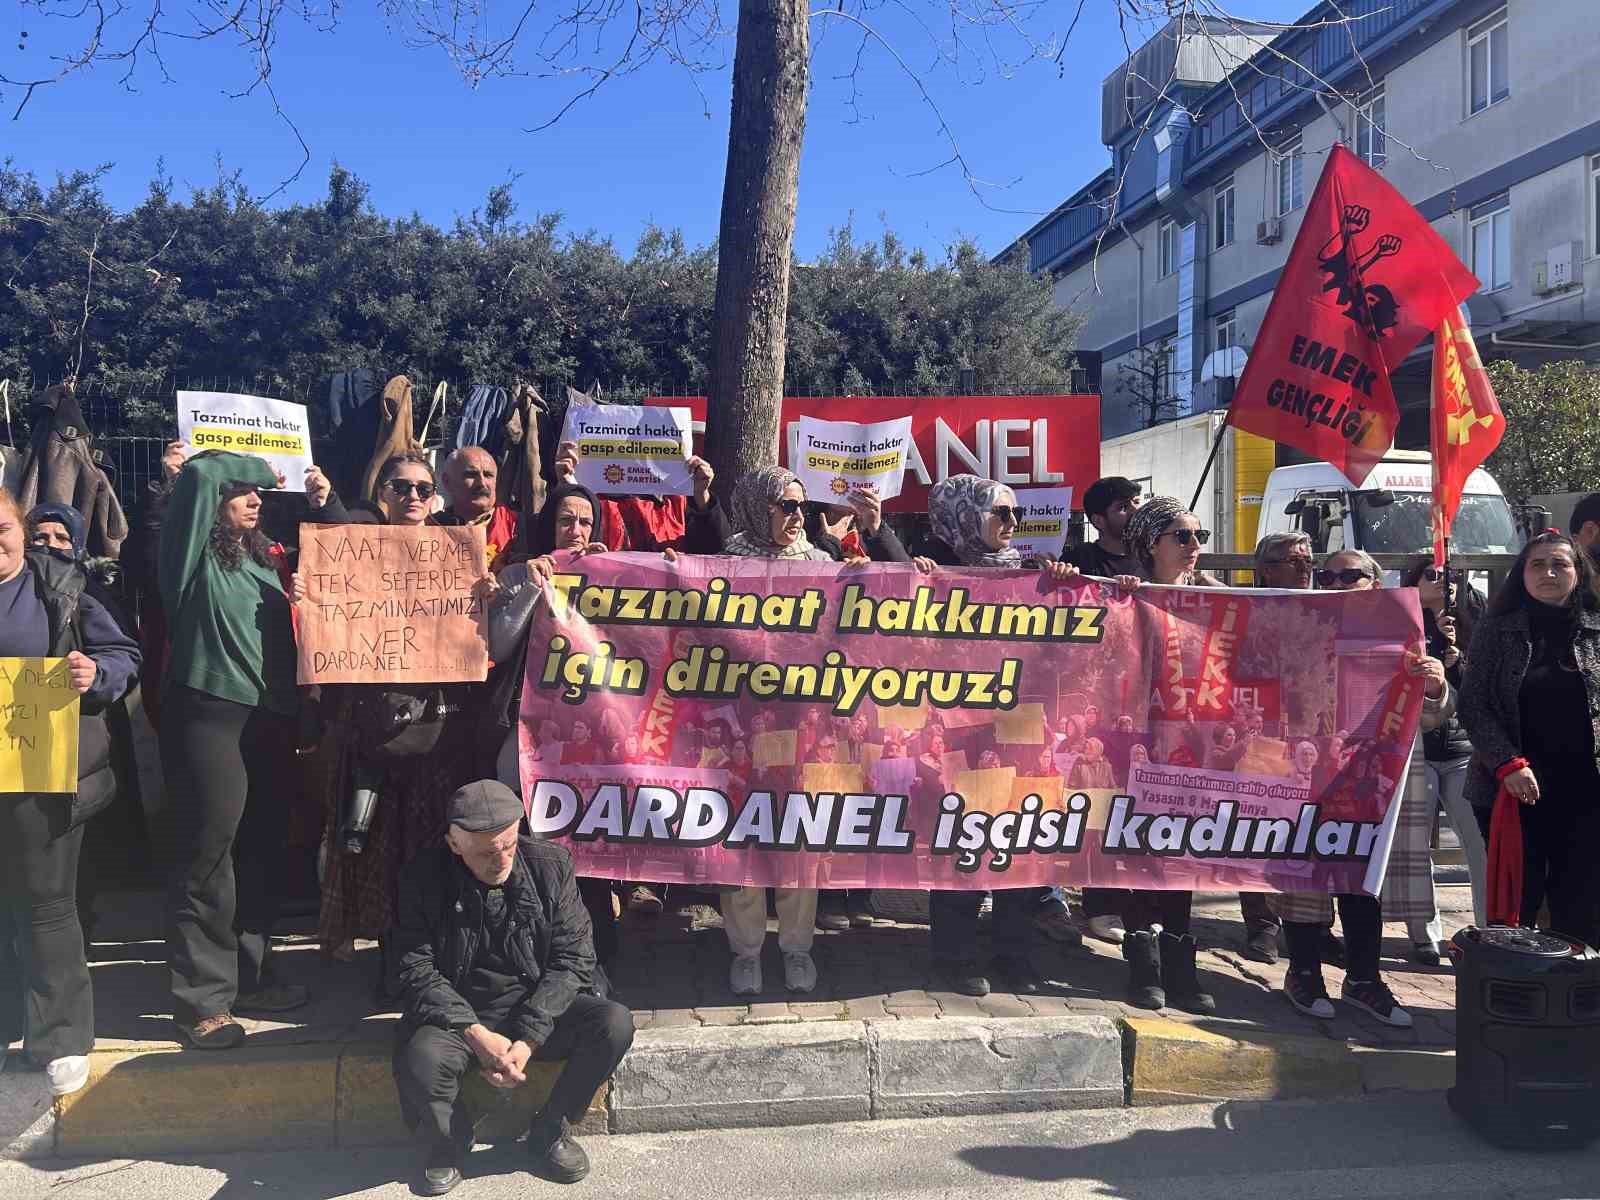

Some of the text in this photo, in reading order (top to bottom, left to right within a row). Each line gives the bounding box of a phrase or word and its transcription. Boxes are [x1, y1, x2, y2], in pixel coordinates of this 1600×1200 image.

[1288, 334, 1377, 398] EMEK
[191, 410, 261, 427] Tazminat
[1267, 378, 1377, 446] GENÇLİĞİ
[195, 433, 302, 450] gasp edilemez!
[579, 422, 641, 436] Tazminat
[581, 441, 682, 456] gasp edilemez!
[807, 435, 903, 453] Tazminat haktır
[808, 450, 900, 471] gasp edilemez!
[1385, 475, 1424, 487] ALLAH
[1030, 504, 1065, 516] haktır
[1012, 519, 1061, 533] dilemez!
[314, 537, 473, 564] VAAT VERME
[312, 568, 467, 595] TEK SEFERDE
[550, 577, 1103, 639] Tazminat hakkımız
[360, 626, 421, 656] VER
[541, 637, 1019, 711] için direniyoruz!
[1135, 769, 1180, 786] Tazminat
[1182, 775, 1234, 792] hakkımıza
[1237, 782, 1267, 797] sahip
[1141, 790, 1185, 807] Yaşasın
[1240, 801, 1269, 816] ünya
[529, 780, 913, 850] DARDANEL
[934, 793, 1087, 867] işçisi
